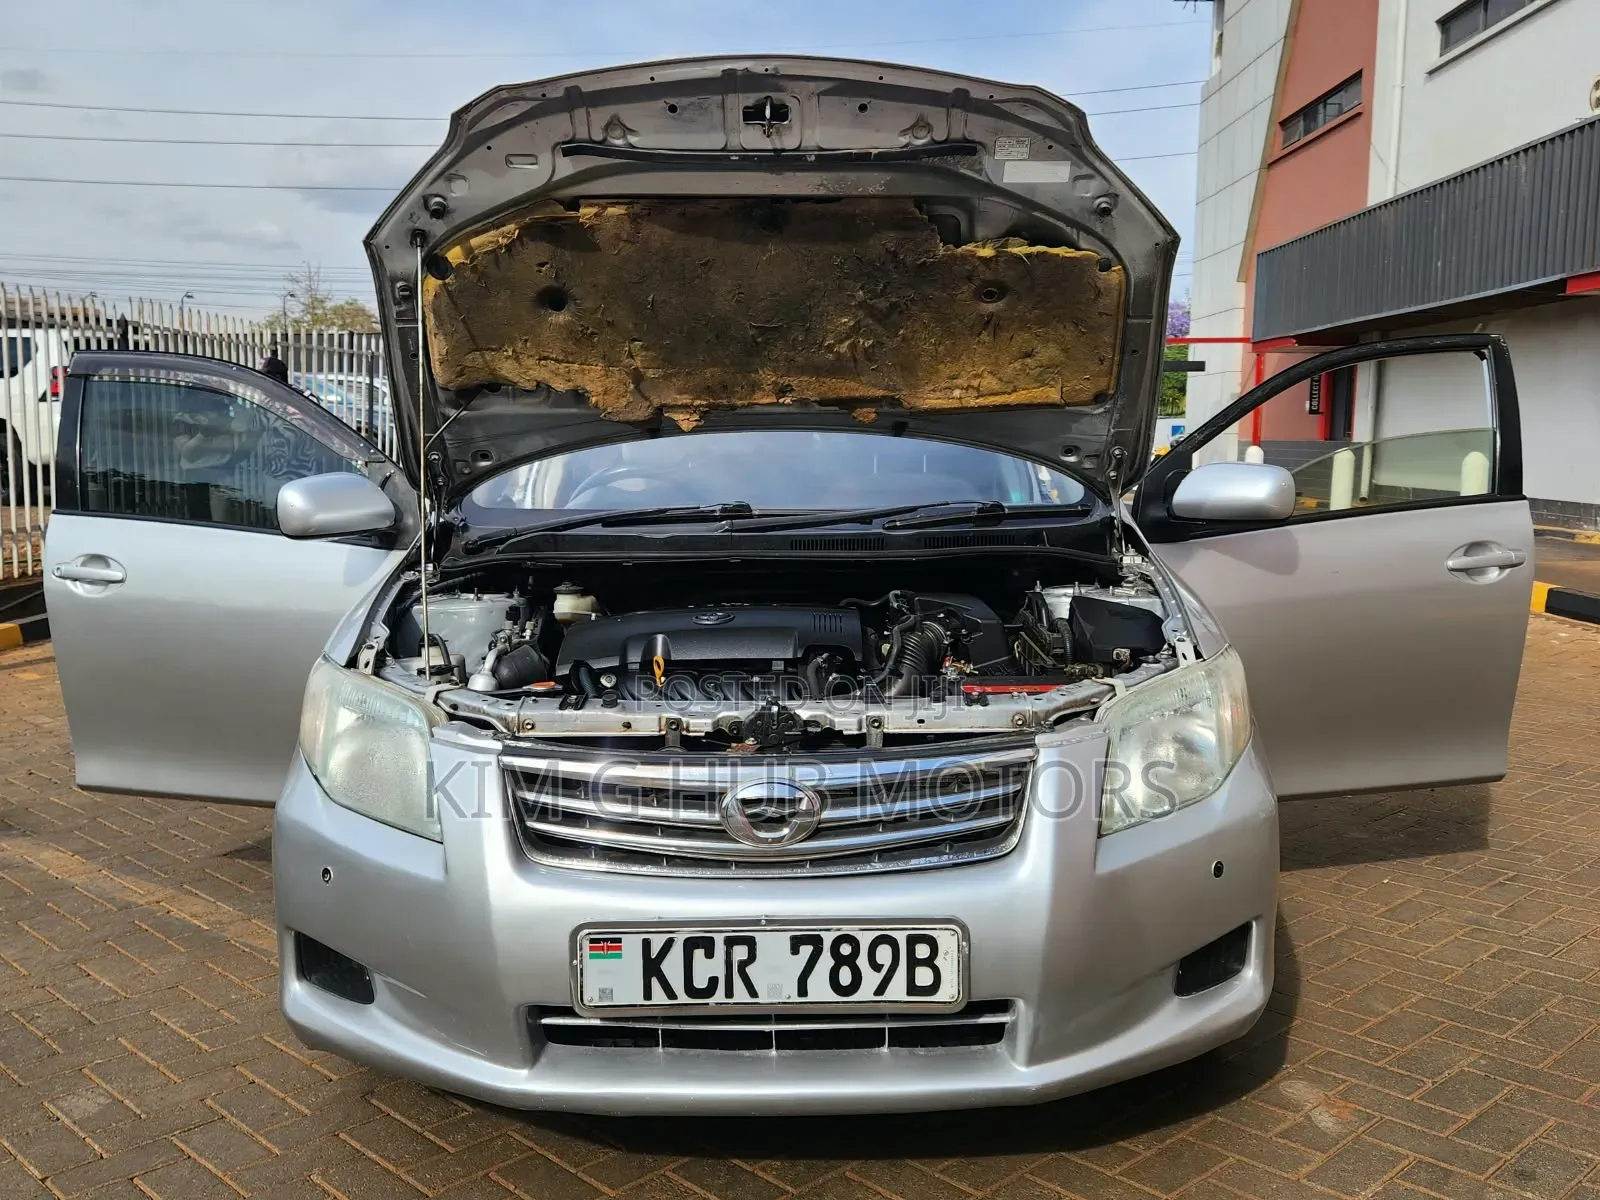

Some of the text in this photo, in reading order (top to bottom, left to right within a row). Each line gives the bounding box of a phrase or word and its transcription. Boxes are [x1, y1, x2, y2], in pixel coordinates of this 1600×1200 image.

[1311, 381, 1319, 410] COLLECT
[641, 935, 759, 1001] KCR
[789, 933, 942, 997] 789B
